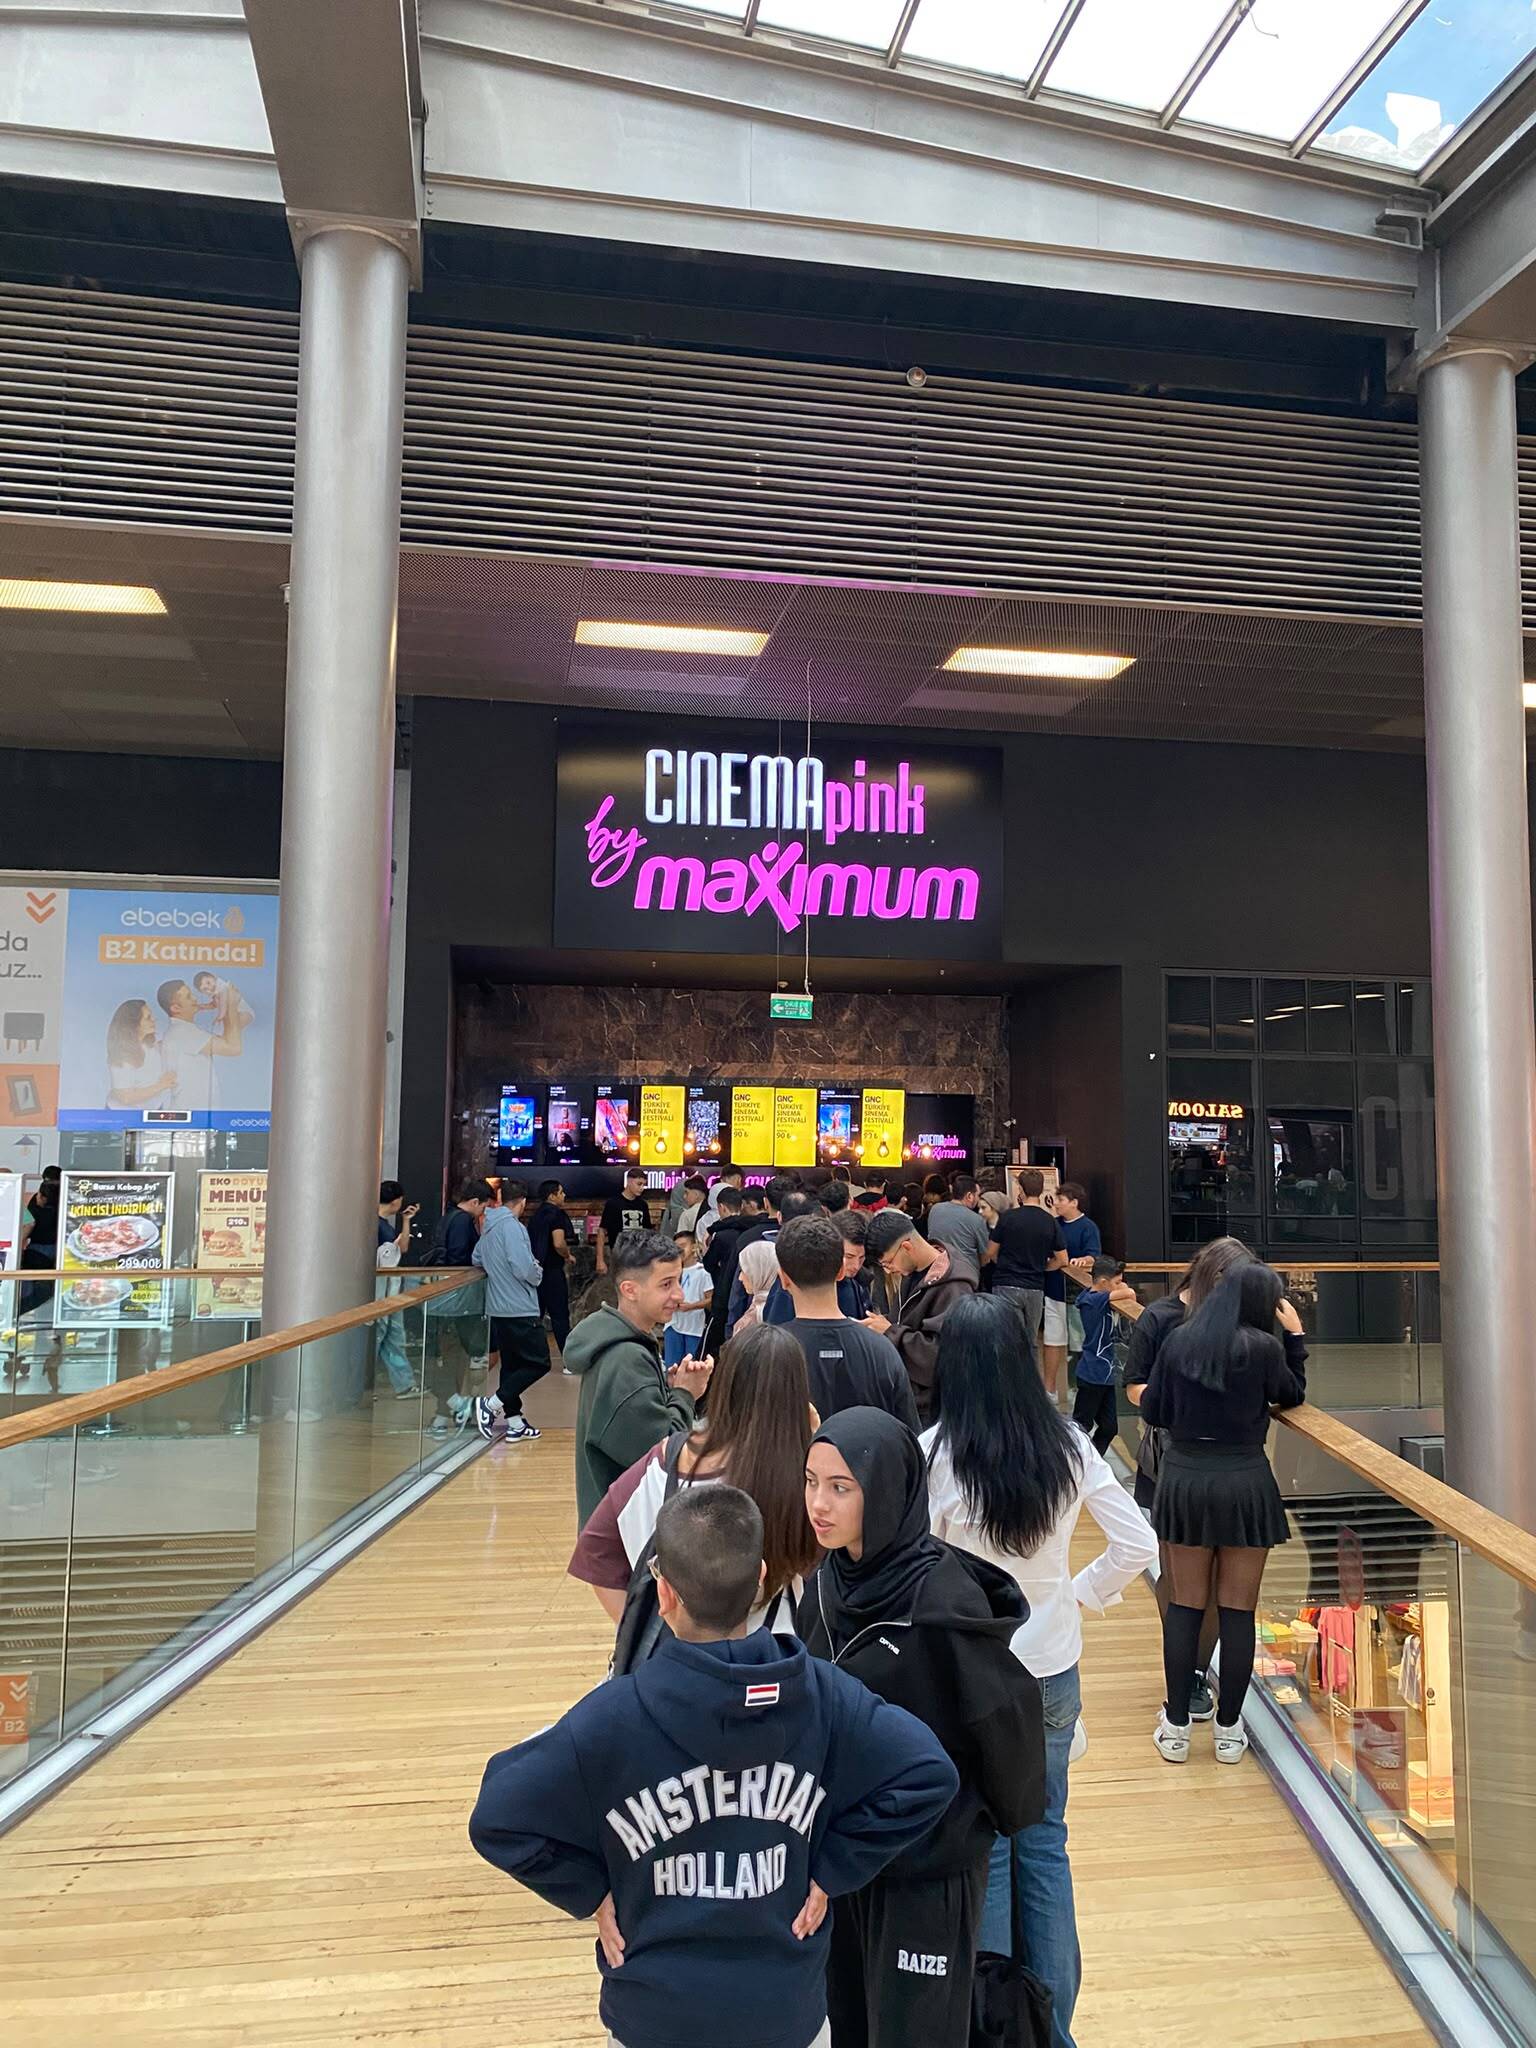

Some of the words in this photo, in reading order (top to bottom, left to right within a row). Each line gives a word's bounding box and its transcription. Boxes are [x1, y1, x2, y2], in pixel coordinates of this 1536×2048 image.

[585, 795, 647, 888] by
[120, 907, 221, 929] ebebek
[105, 940, 137, 960] B2
[142, 941, 257, 963] Katında!
[0, 962, 42, 979] uz...
[210, 1178, 231, 1186] EKO
[232, 1178, 265, 1186] DOYU
[4, 1720, 25, 1733] B2
[654, 1843, 787, 1900] HOLLAND
[897, 1949, 948, 1976] RAIZE
